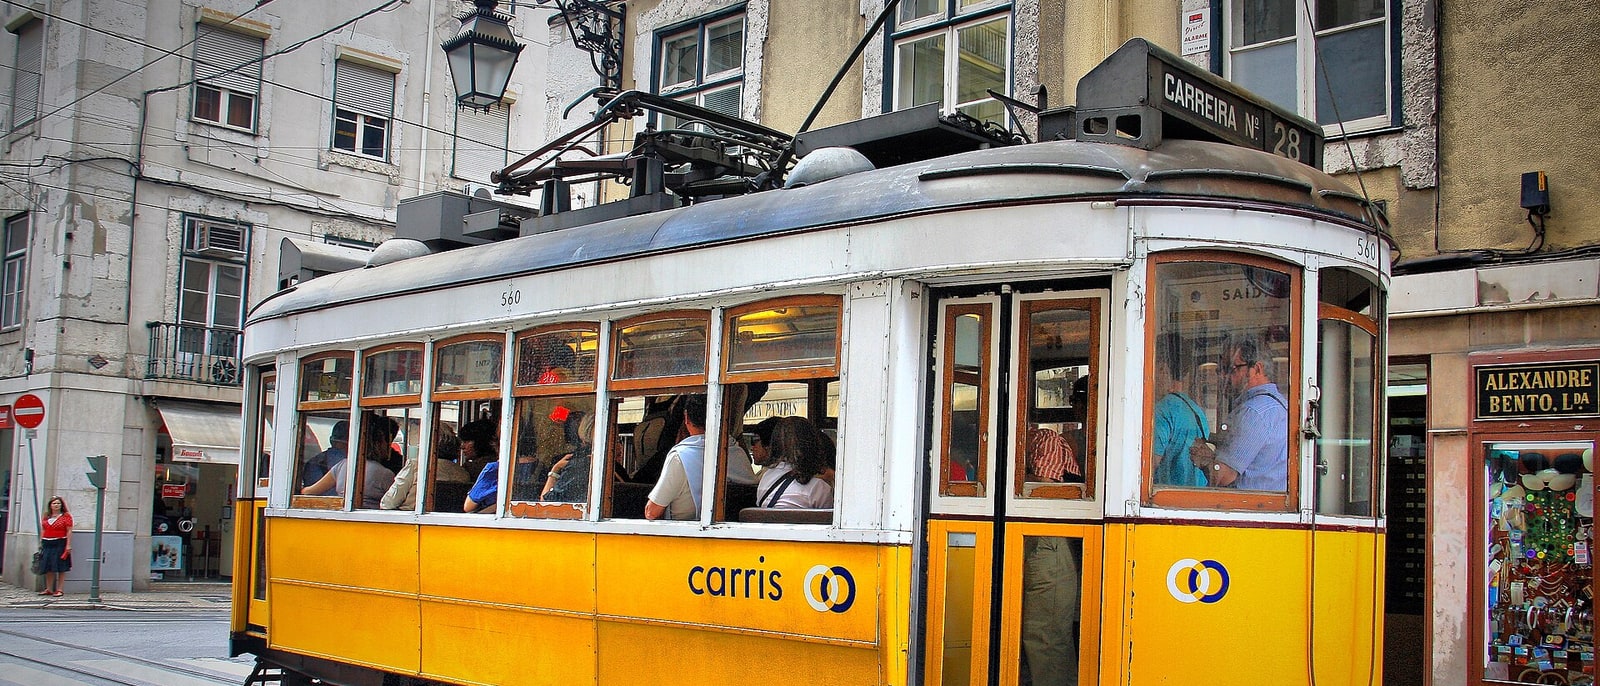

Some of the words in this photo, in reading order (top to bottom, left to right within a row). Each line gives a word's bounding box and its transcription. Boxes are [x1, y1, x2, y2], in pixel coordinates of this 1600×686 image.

[1184, 33, 1208, 42] ALARME
[1164, 73, 1237, 131] CARREIRA
[1273, 122, 1301, 161] 28
[1357, 237, 1376, 261] 560
[501, 290, 521, 306] 560
[1485, 369, 1592, 391] ALEXANDRE
[688, 556, 783, 601] carris
